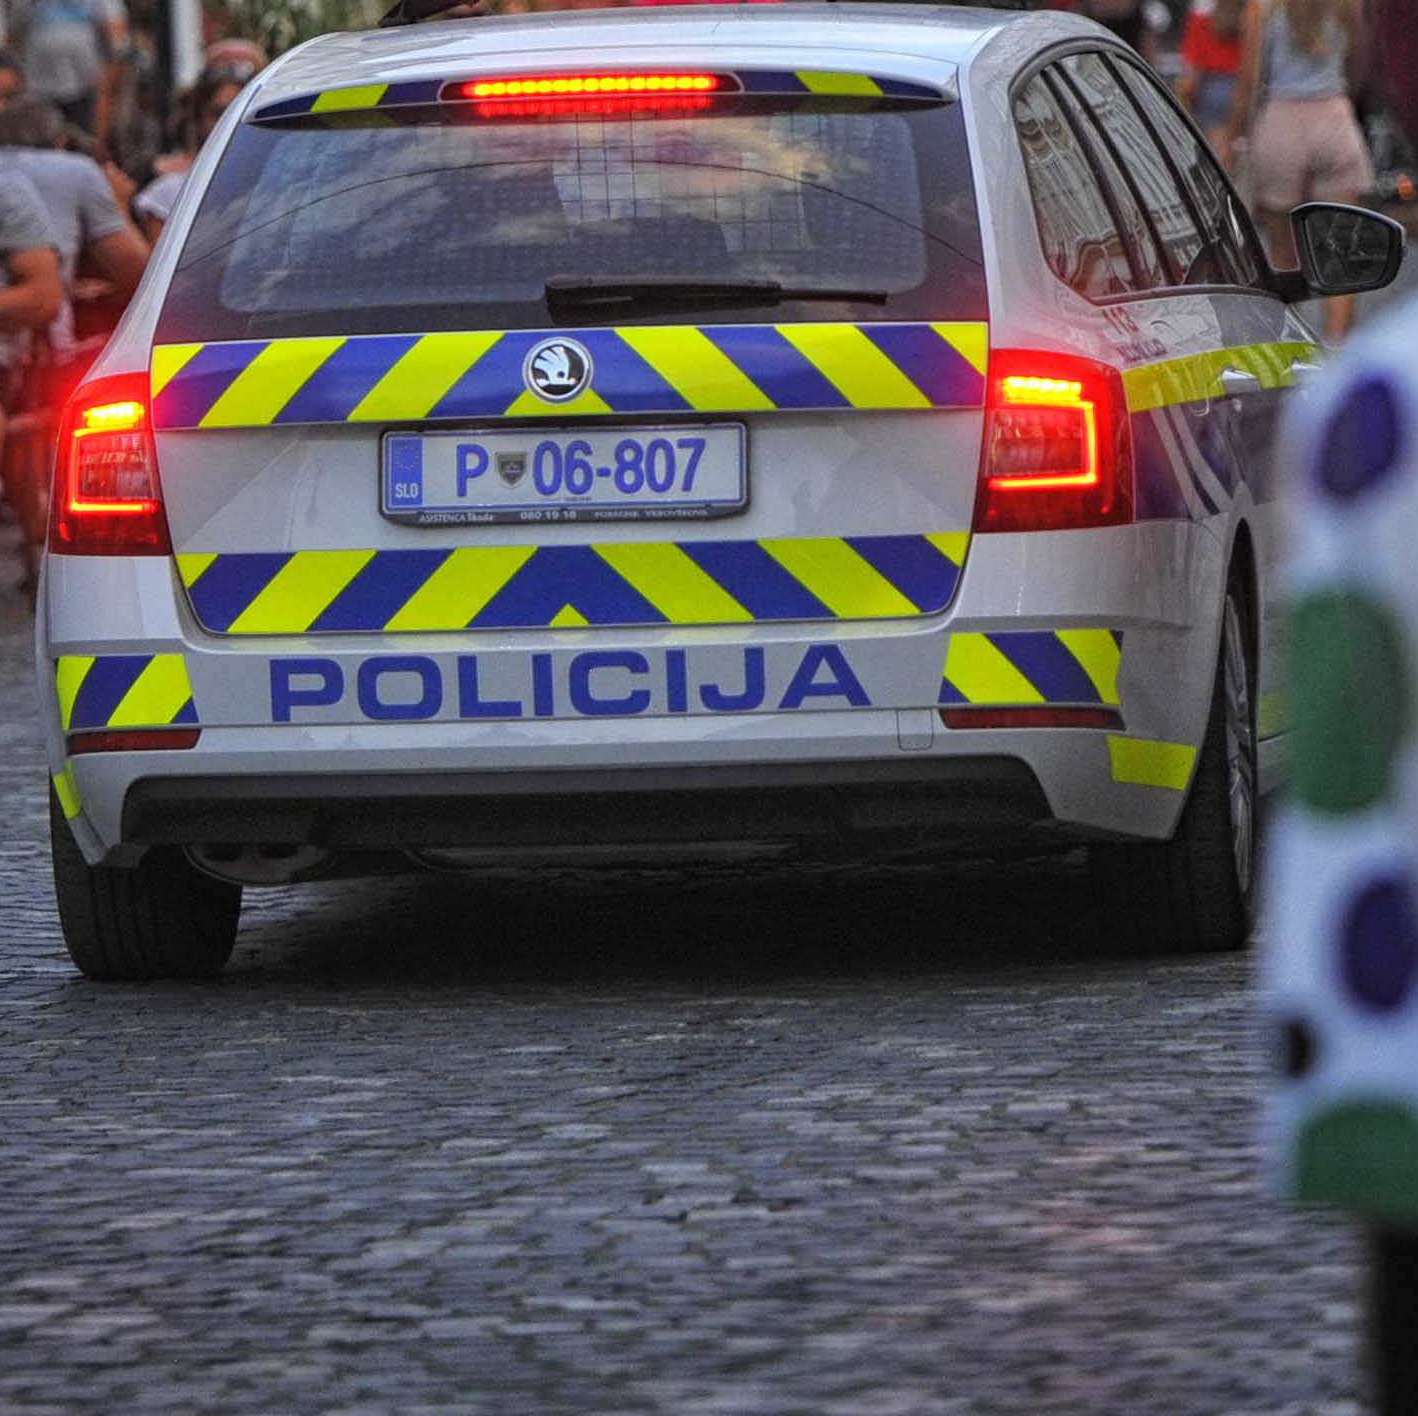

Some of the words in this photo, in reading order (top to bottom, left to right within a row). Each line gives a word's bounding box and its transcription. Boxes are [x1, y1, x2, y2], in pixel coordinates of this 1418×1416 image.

[394, 482, 419, 500] SLO
[455, 443, 490, 498] P
[532, 437, 707, 496] 06-807
[268, 643, 873, 723] POLICIJA
